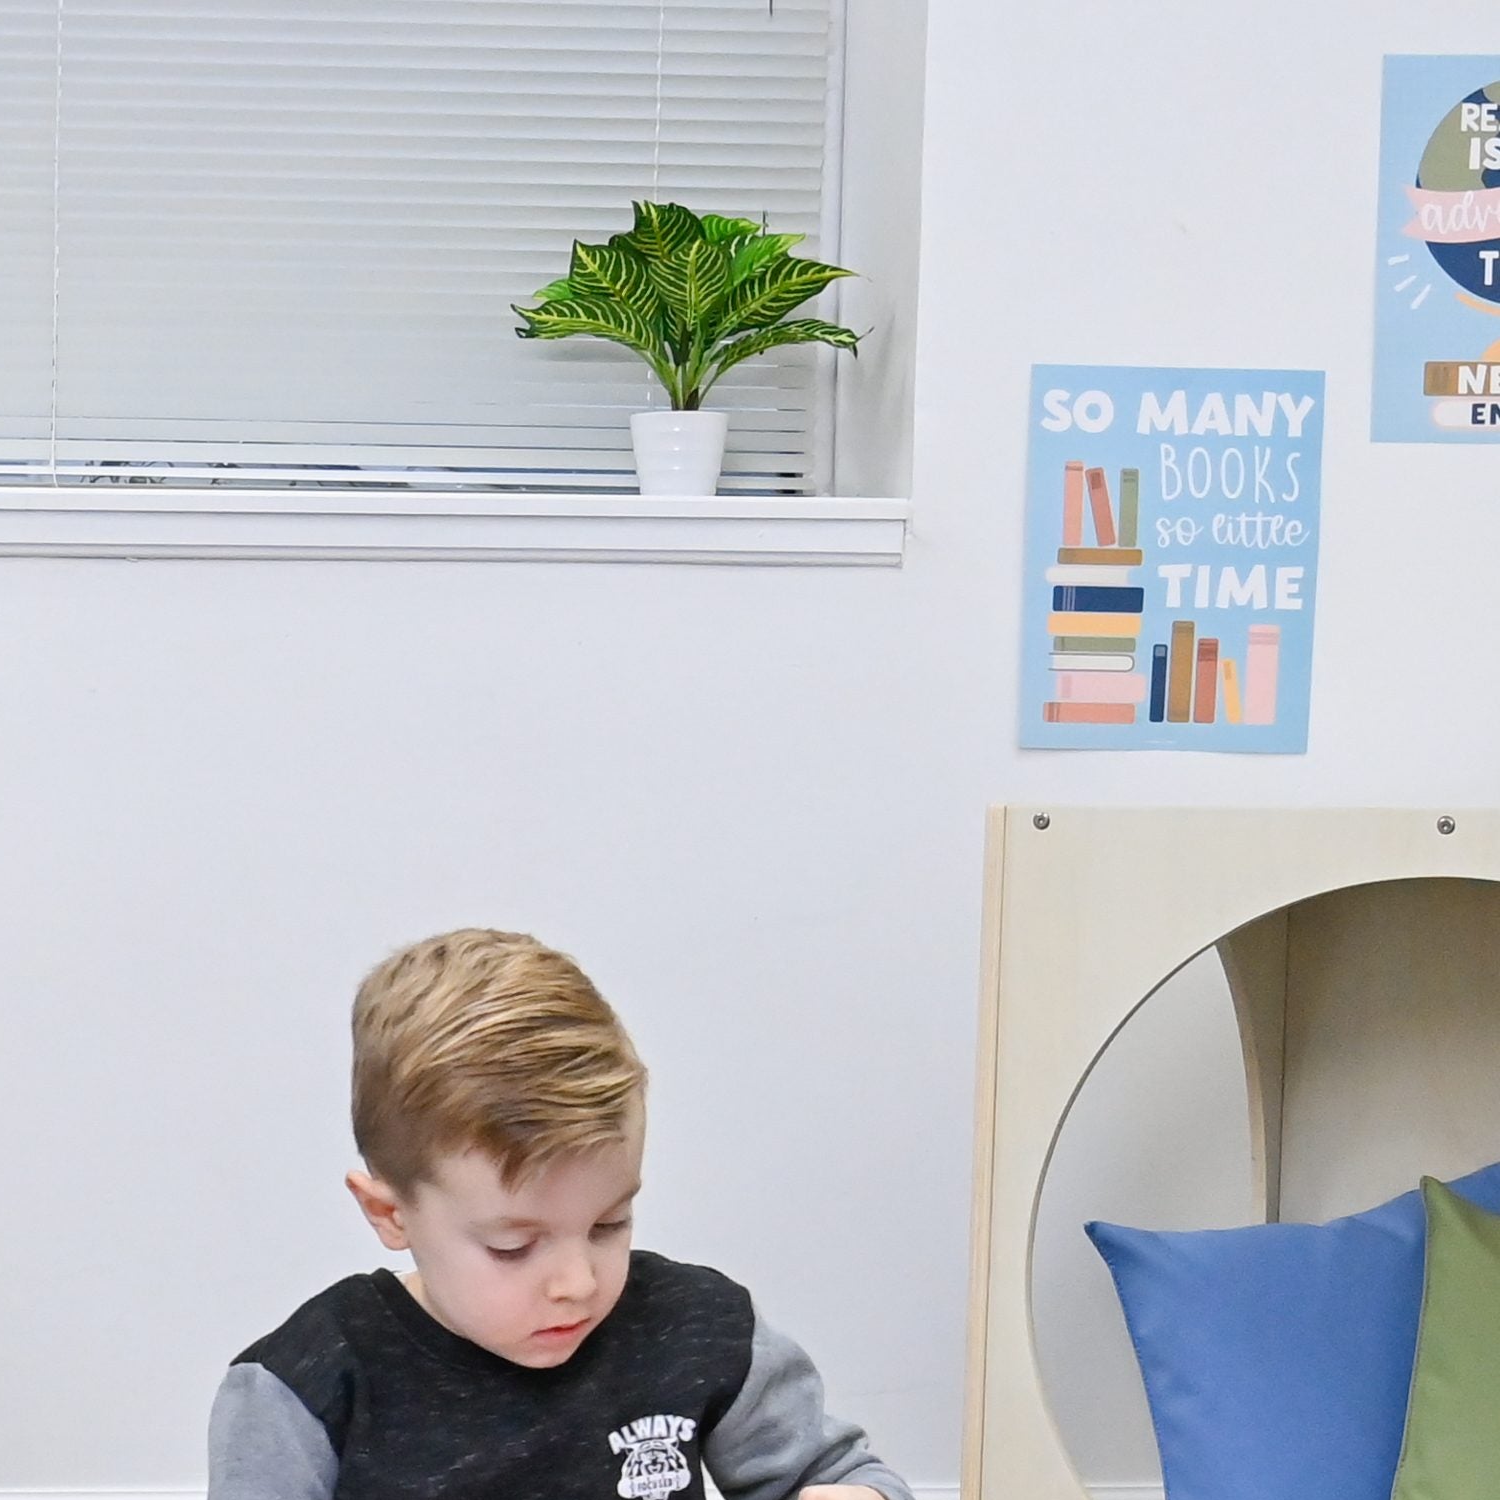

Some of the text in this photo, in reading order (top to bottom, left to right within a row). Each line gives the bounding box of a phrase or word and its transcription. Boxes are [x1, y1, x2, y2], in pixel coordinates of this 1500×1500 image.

[1461, 103, 1500, 132] RE
[1420, 190, 1500, 234] adv
[1040, 389, 1315, 437] SO MANY
[1159, 444, 1302, 504] BOOKS
[1155, 511, 1310, 549] so little
[1158, 564, 1304, 611] TIME
[608, 1415, 696, 1455] ALWAYS
